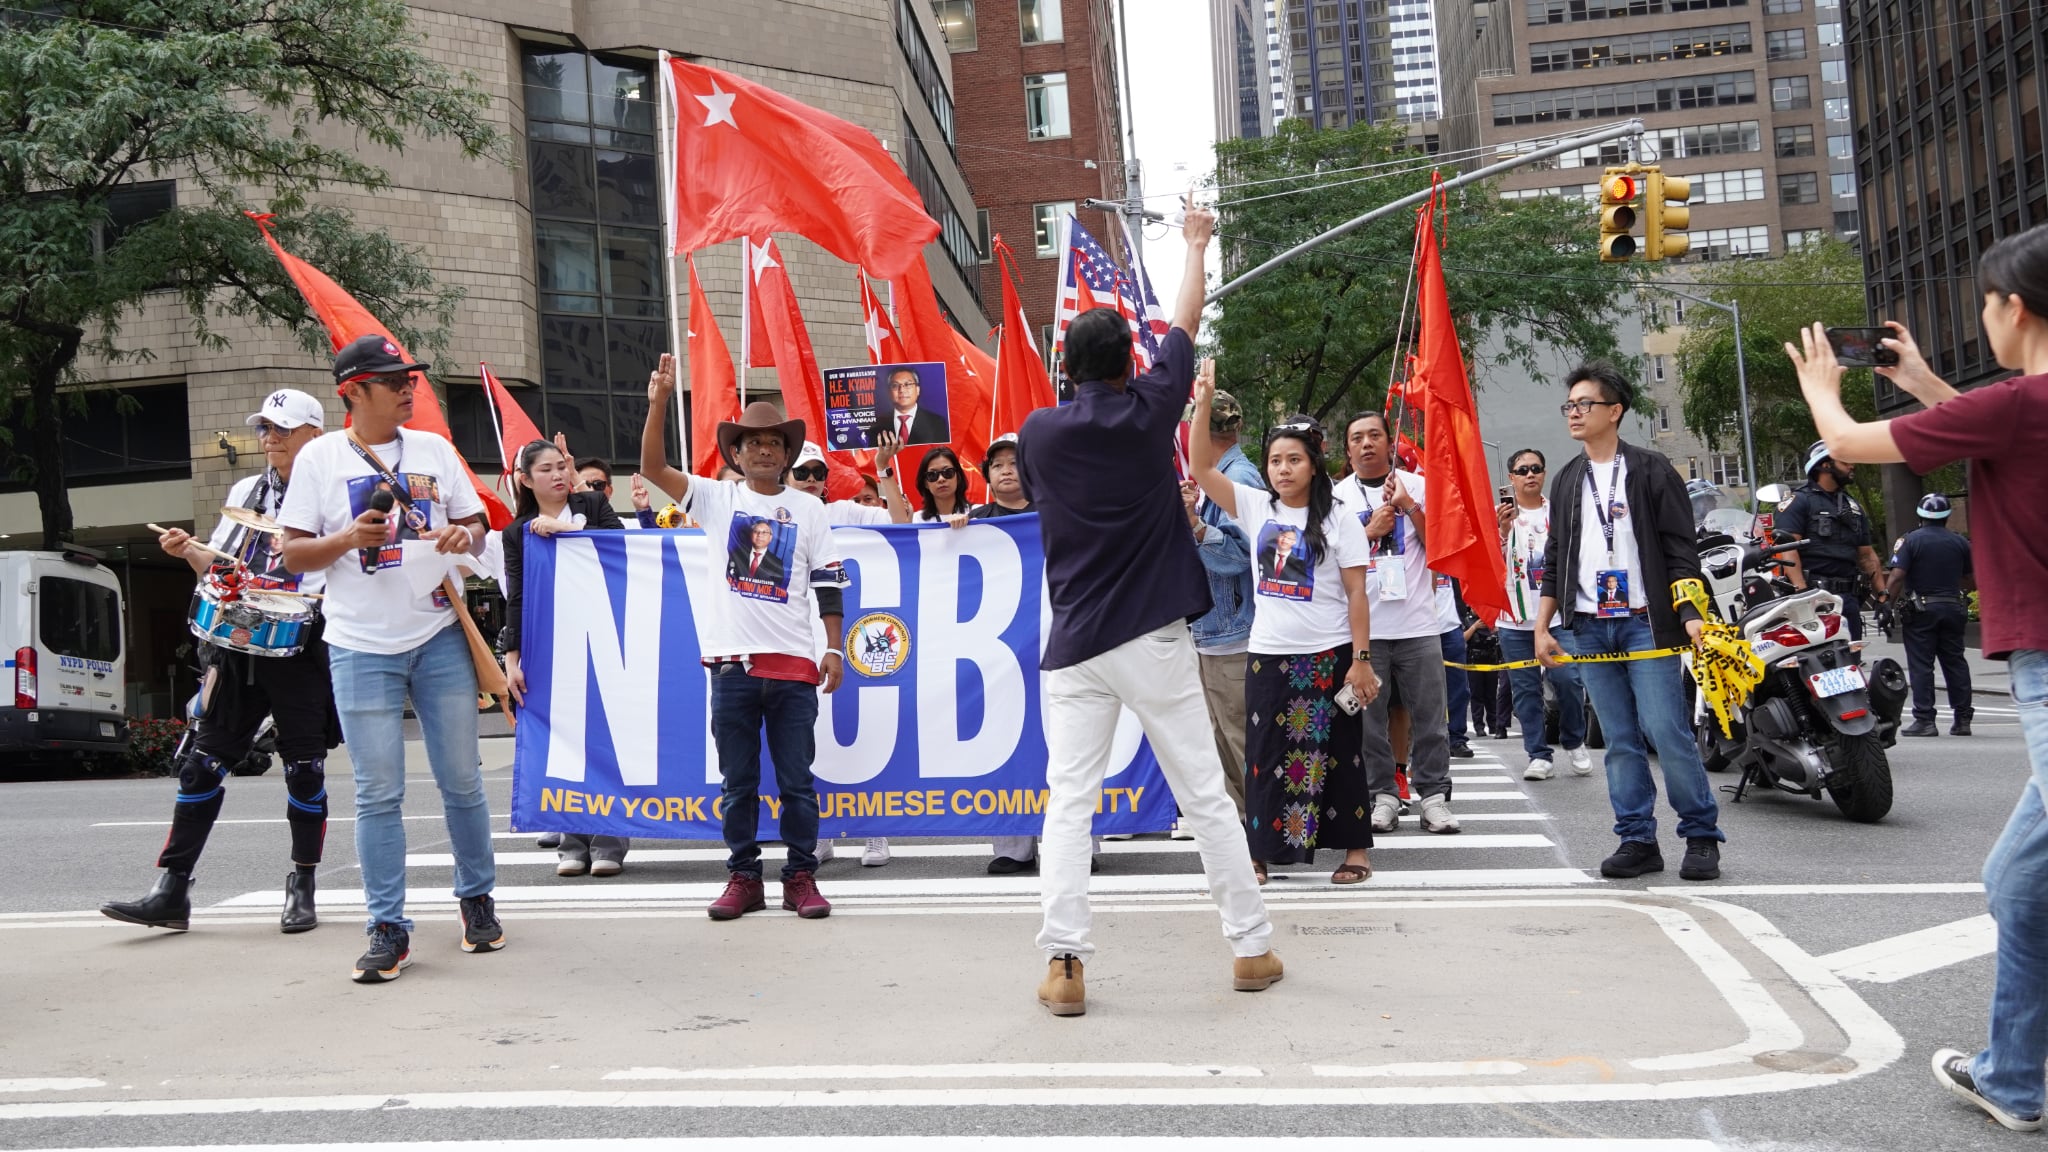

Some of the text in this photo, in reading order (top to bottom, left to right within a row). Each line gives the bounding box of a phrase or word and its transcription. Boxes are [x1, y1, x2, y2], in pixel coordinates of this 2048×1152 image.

[829, 378, 876, 393] H.E. KYAW
[269, 394, 287, 408] NY
[830, 393, 875, 408] MOE TUN
[407, 474, 431, 488] FREE
[60, 656, 84, 669] NYPD
[87, 660, 113, 673] POLICE
[861, 652, 897, 664] NYC
[871, 662, 896, 673] BC
[1820, 674, 1847, 692] 2447
[1827, 683, 1858, 695] POLICE
[541, 788, 615, 816] NEW
[620, 795, 708, 822] YORK
[817, 790, 945, 818] URMESE
[950, 787, 1144, 816] COMMITY
